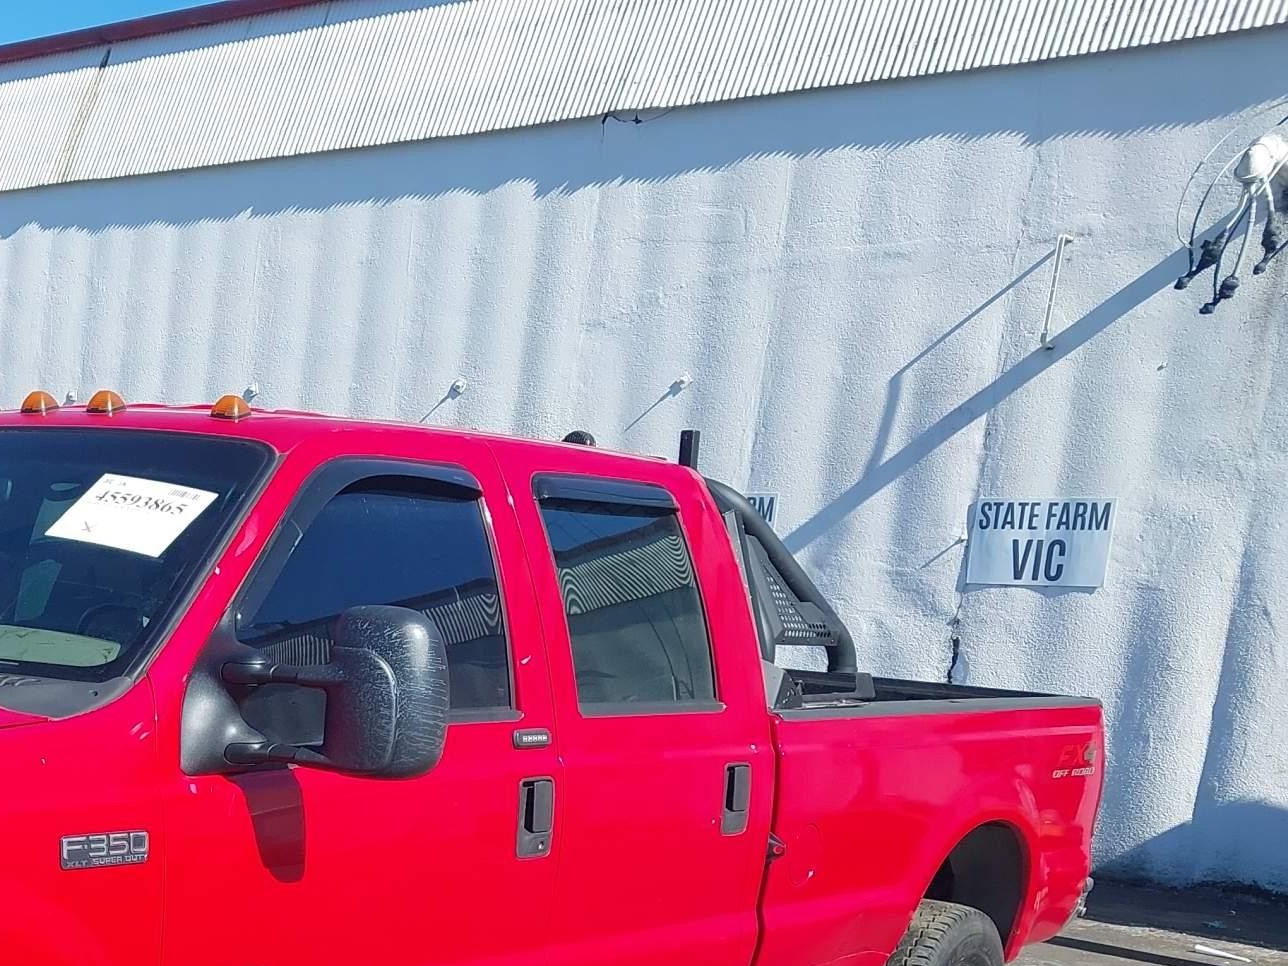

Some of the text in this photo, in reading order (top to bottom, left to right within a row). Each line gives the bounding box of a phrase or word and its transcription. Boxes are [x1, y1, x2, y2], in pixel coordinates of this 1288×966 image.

[95, 489, 189, 515] 45593865
[978, 501, 1112, 531] STATE FARM
[1012, 538, 1066, 582] VIC
[92, 855, 123, 866] SUPER
